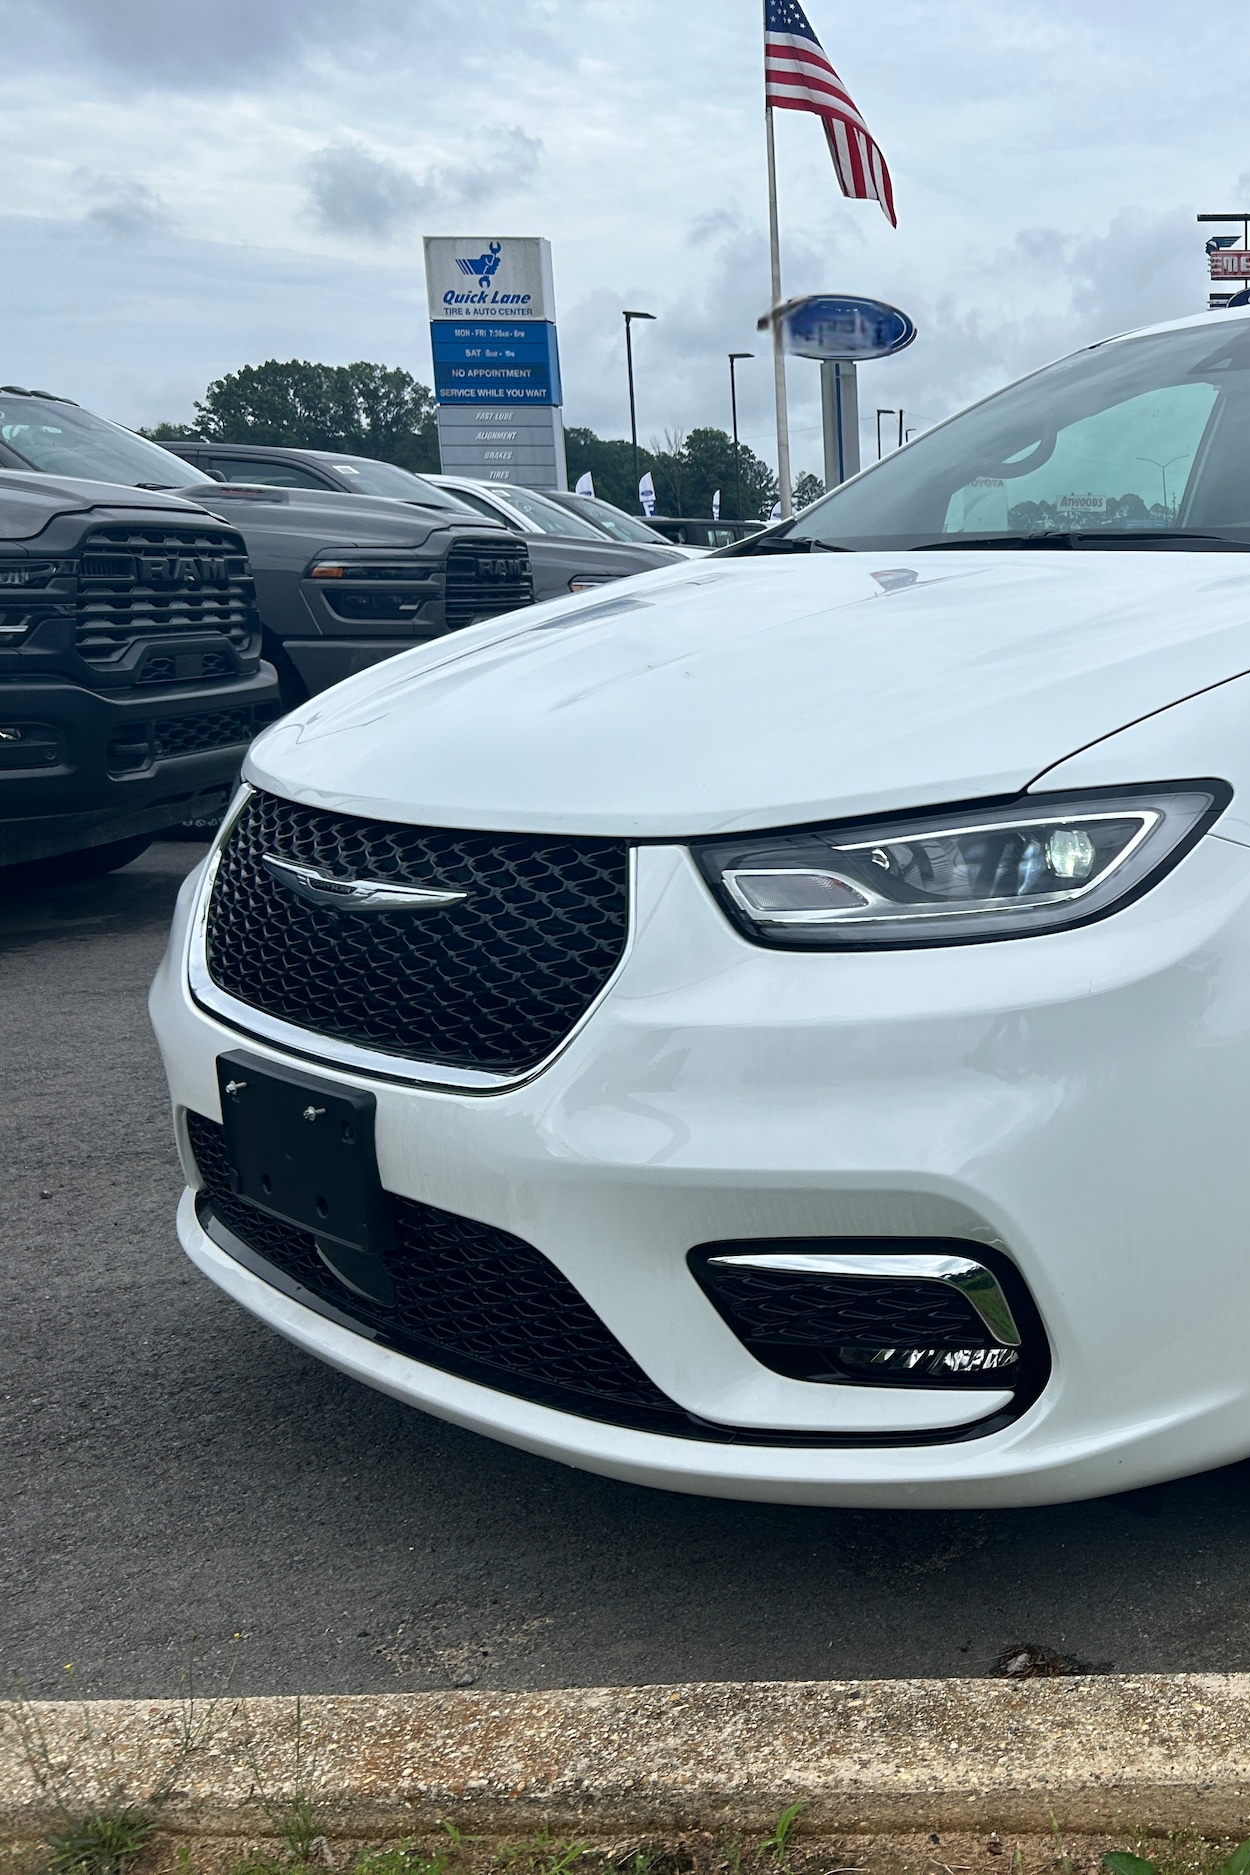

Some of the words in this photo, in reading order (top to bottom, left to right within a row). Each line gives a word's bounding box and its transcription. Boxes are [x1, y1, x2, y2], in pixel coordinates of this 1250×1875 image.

[442, 289, 489, 306] Quick
[490, 290, 532, 305] Lane
[443, 307, 464, 316] TIRE
[465, 307, 471, 316] &
[473, 307, 497, 316] AUTO
[498, 307, 533, 316] CENTER
[454, 328, 471, 338] MON
[475, 328, 487, 338] FRI
[465, 349, 482, 358] SAT
[452, 369, 466, 378] NO
[467, 368, 532, 378] APPOINTMENT
[440, 388, 476, 398] SERVICE
[477, 388, 505, 398] WHILE
[506, 388, 524, 398] YOU
[525, 388, 547, 398] WAIT
[475, 431, 518, 441] ALIGNMENT
[483, 451, 513, 461] BRAKES
[489, 471, 511, 480] TIRES
[139, 557, 227, 581] RAM
[478, 559, 521, 575] RAM
